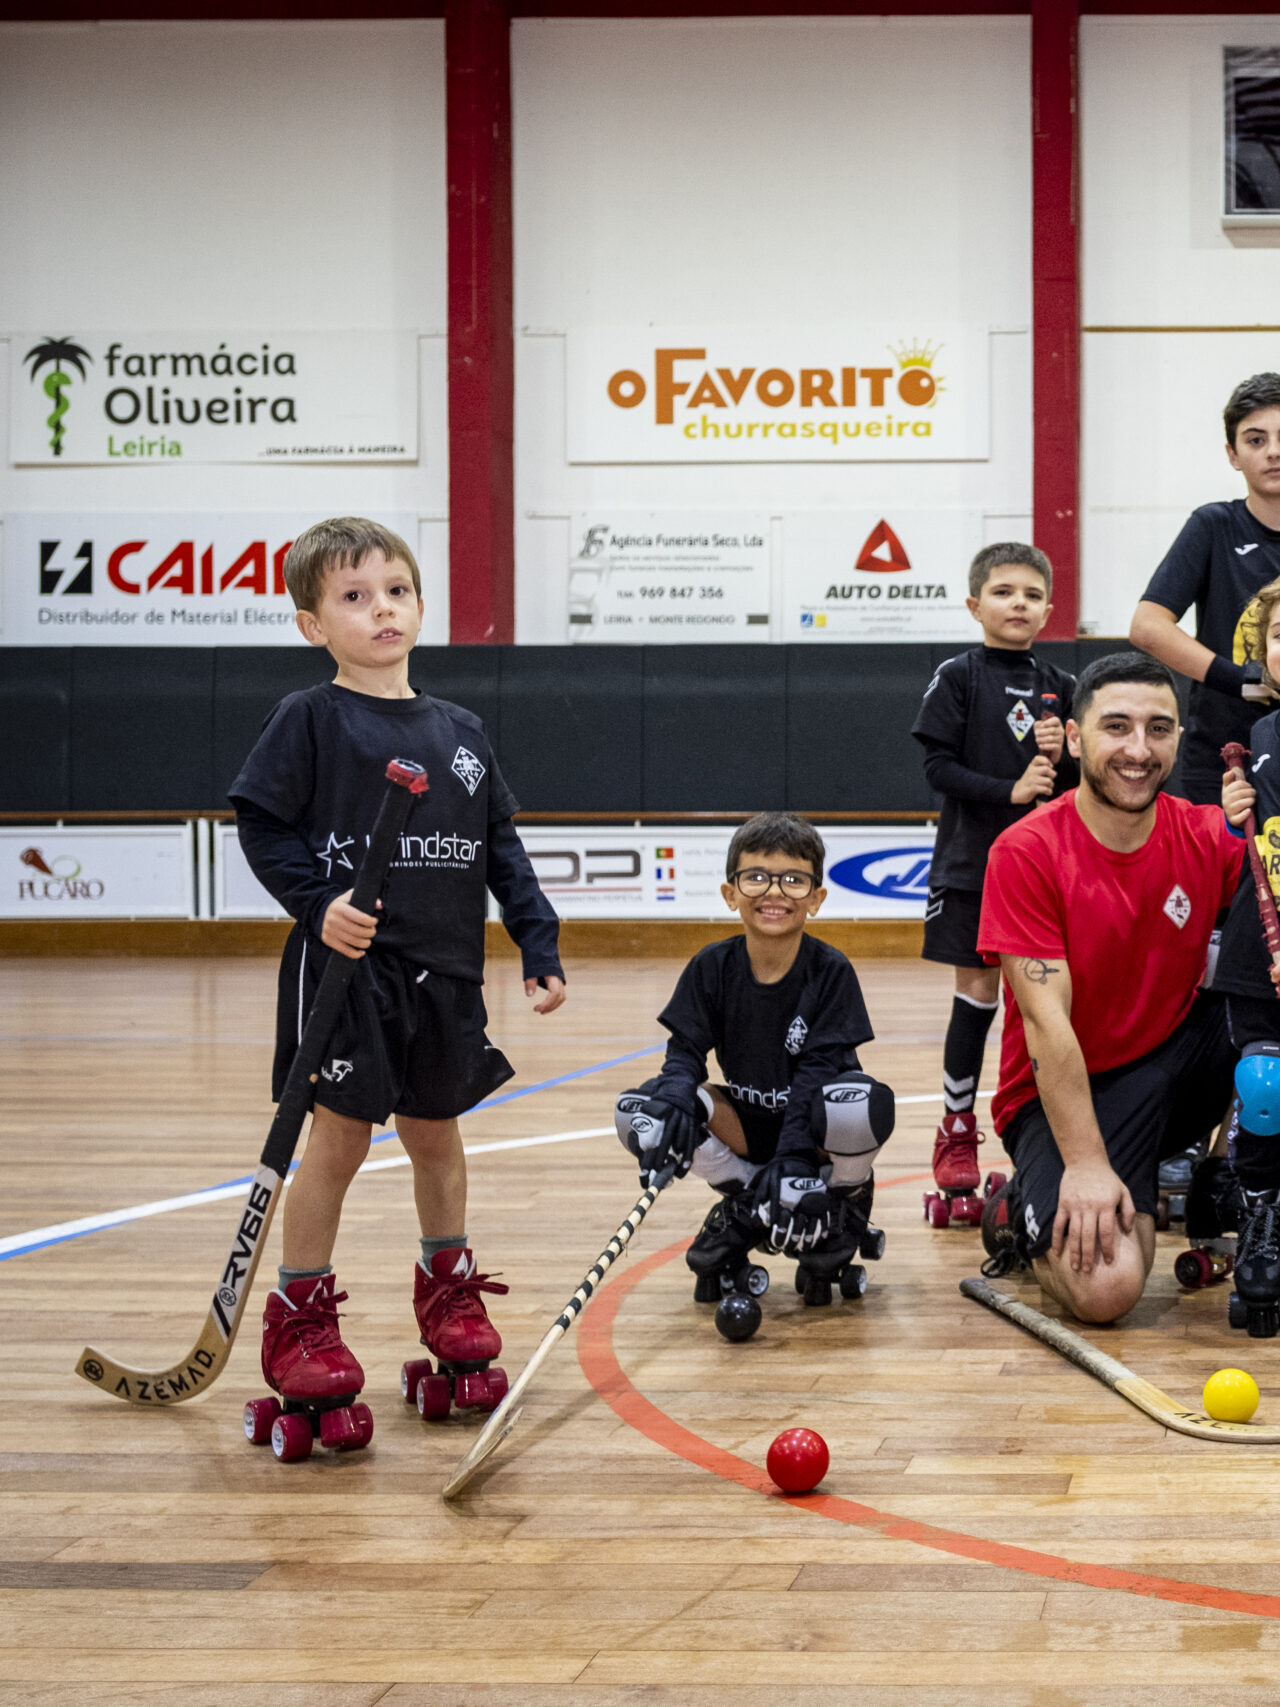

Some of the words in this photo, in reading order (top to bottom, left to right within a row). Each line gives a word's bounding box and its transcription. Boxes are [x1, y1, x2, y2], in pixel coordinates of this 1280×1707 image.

[104, 342, 297, 377] farmácia
[104, 386, 298, 425] Oliveira
[683, 414, 932, 445] churrasqueira
[107, 436, 183, 458] Leiria
[609, 534, 652, 550] Agência
[655, 534, 709, 547] Funerária
[640, 586, 665, 599] 969
[669, 586, 694, 599] 847
[699, 586, 724, 599] 356
[825, 584, 882, 599] AUTO
[888, 584, 947, 599] DELTA
[38, 608, 137, 626] Distribuidor
[145, 608, 165, 625] de
[171, 608, 238, 625] Material
[648, 615, 684, 625] MONTE
